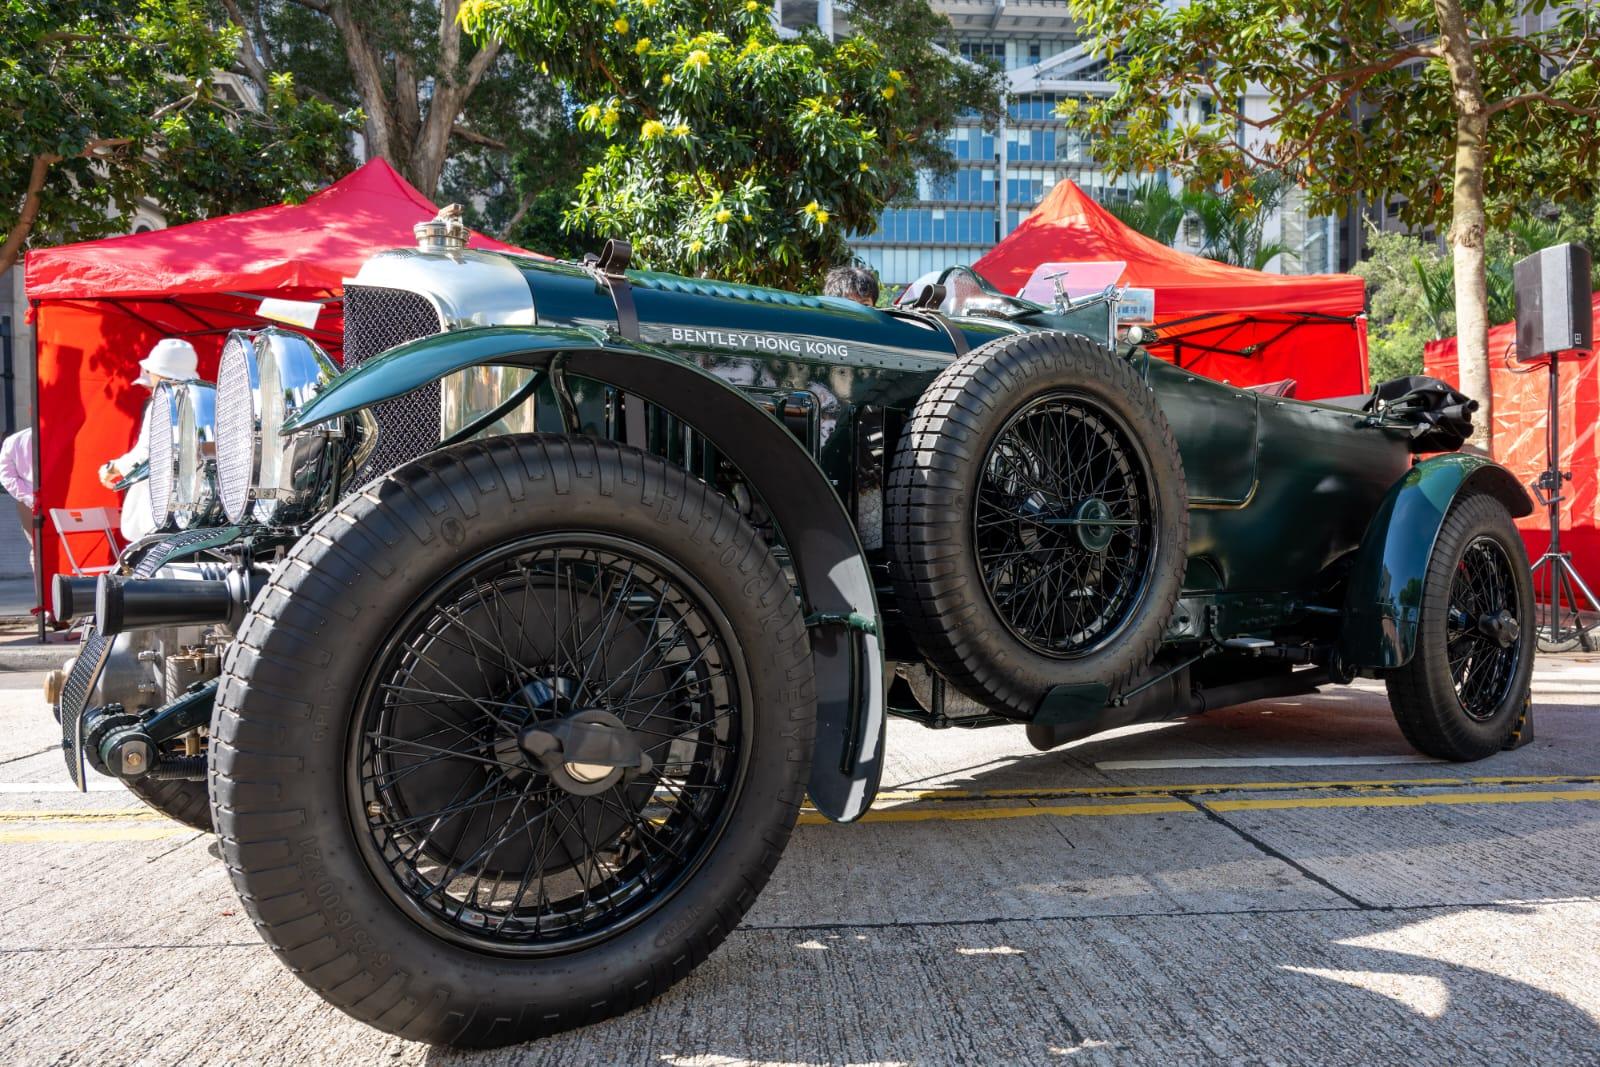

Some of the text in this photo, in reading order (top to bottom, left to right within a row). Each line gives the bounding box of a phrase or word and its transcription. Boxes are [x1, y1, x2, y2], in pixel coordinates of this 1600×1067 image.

[671, 327, 848, 357] BENTLEY HONG KONG
